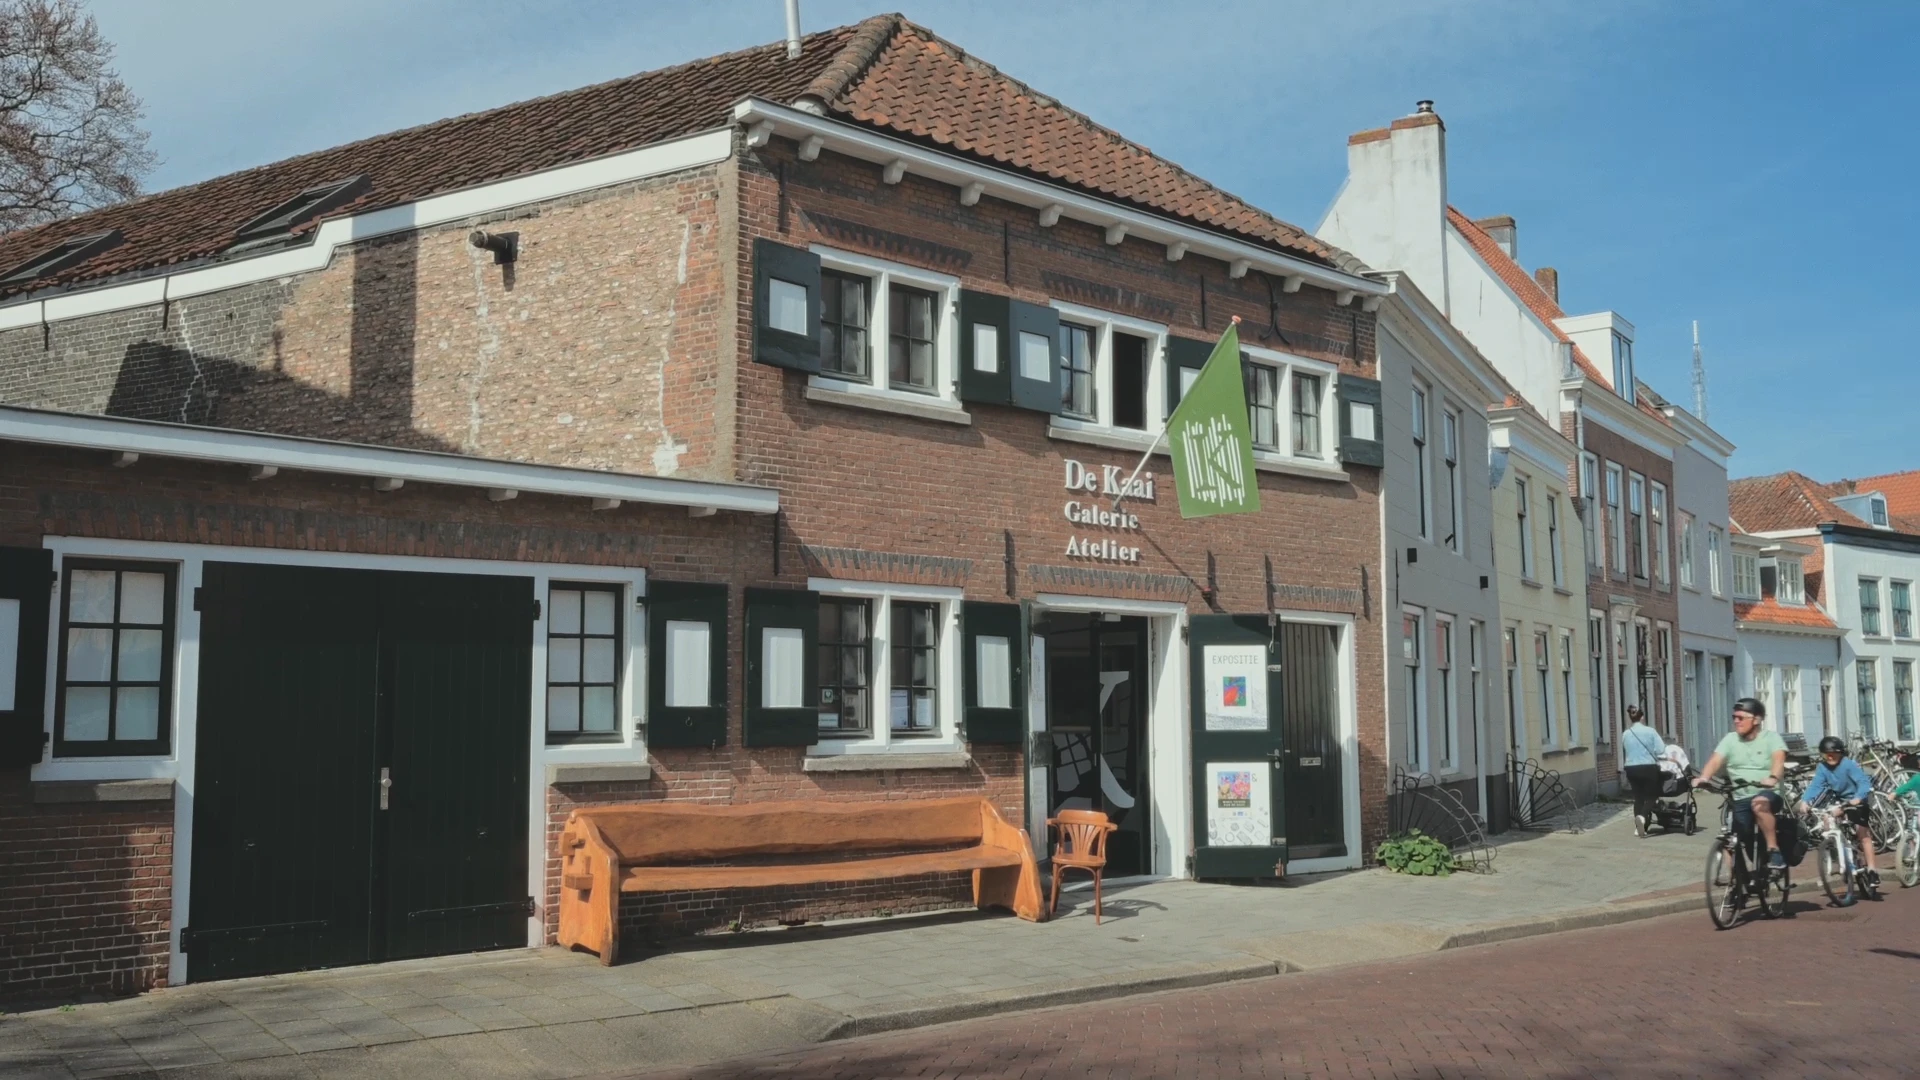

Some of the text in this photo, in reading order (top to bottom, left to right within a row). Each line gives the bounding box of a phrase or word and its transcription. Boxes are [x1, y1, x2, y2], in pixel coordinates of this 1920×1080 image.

[1064, 459, 1154, 499] De Kaai
[1064, 501, 1138, 529] Galerie
[1065, 536, 1140, 562] Atelier
[1212, 654, 1259, 665] EXPOSITIE
